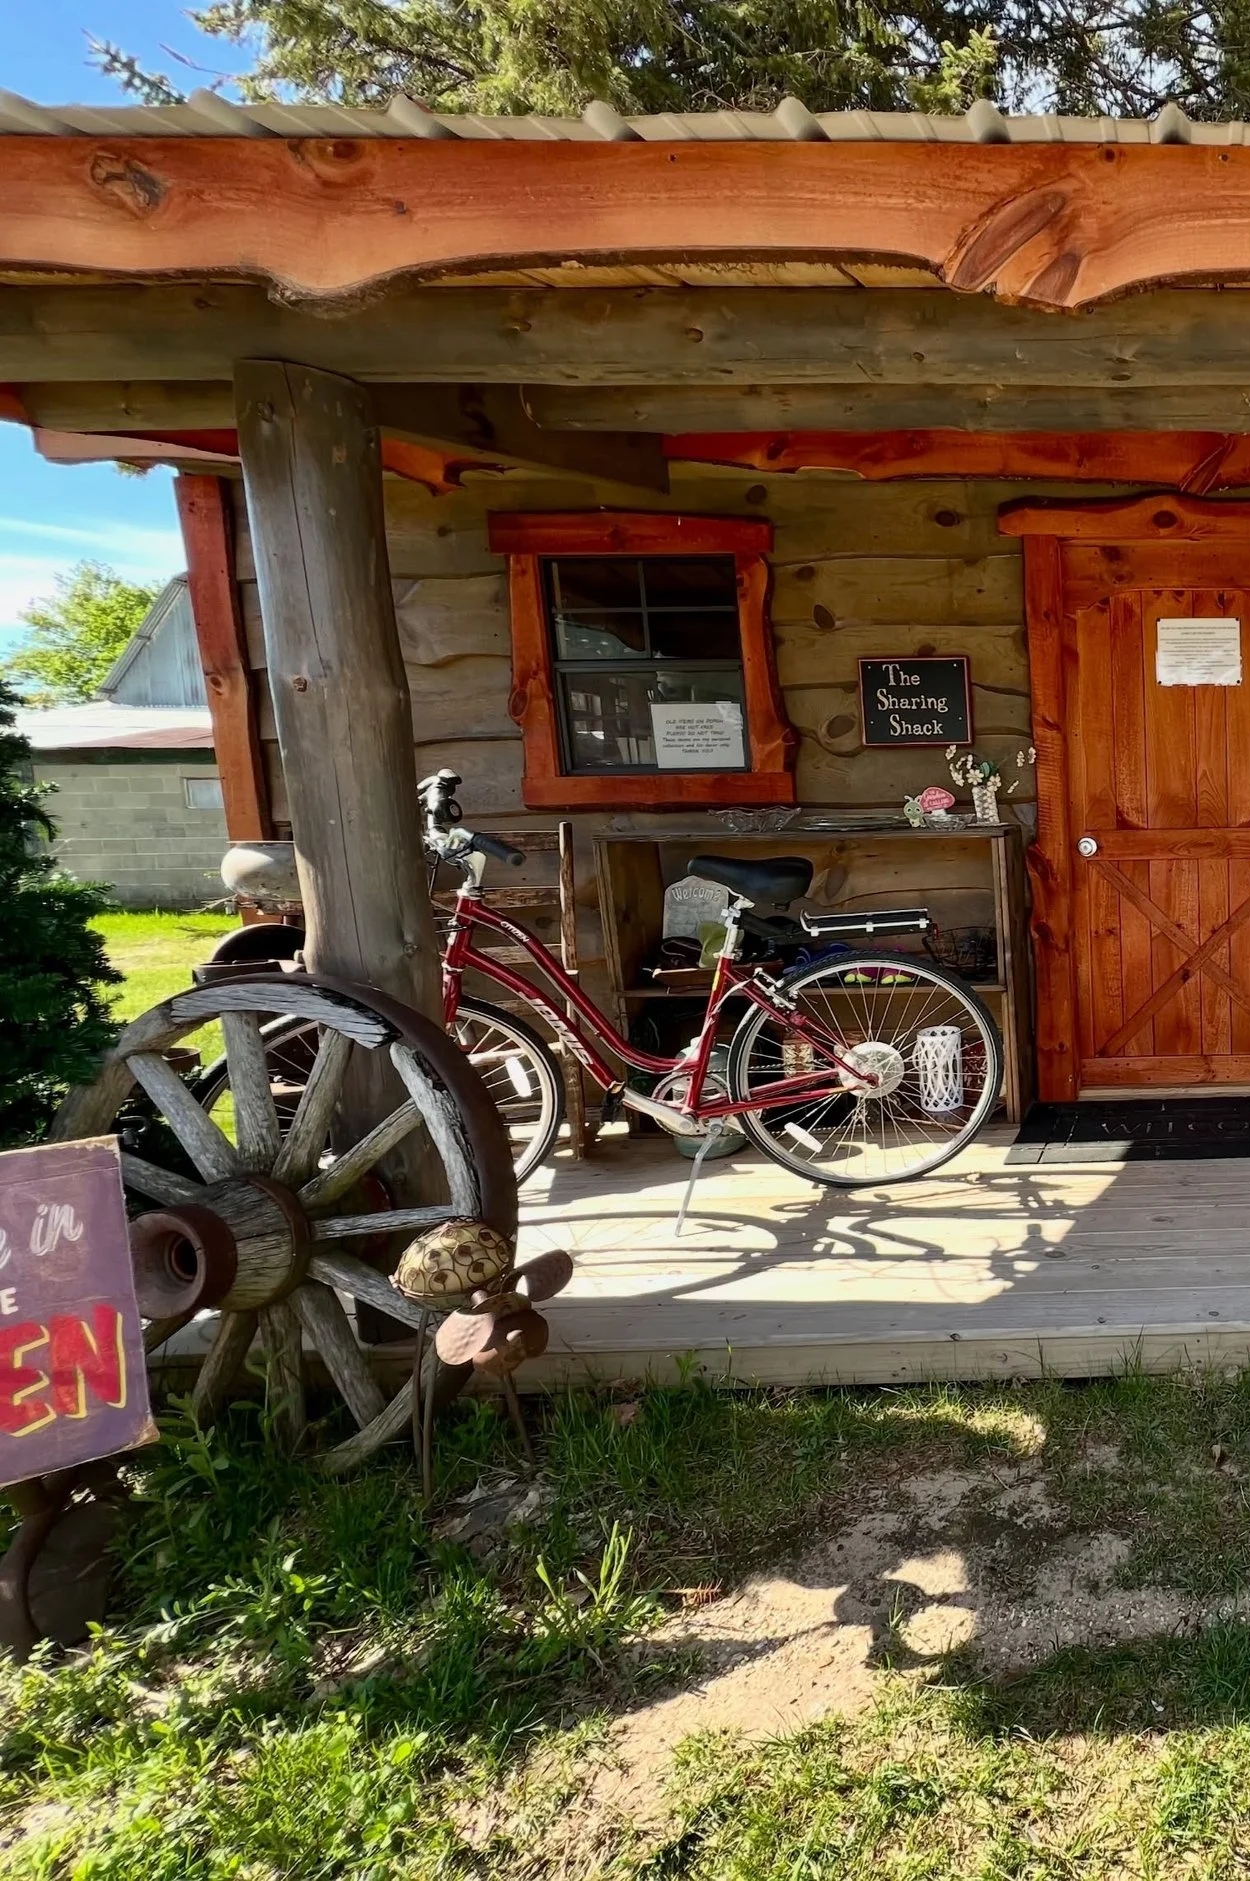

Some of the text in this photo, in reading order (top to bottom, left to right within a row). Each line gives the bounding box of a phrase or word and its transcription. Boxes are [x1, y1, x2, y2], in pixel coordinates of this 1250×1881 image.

[882, 664, 921, 686] The
[876, 688, 949, 713] Sharing
[889, 714, 944, 736] Shack
[671, 886, 721, 902] Welcome
[500, 920, 530, 943] CITIZEN
[29, 1203, 84, 1257] in
